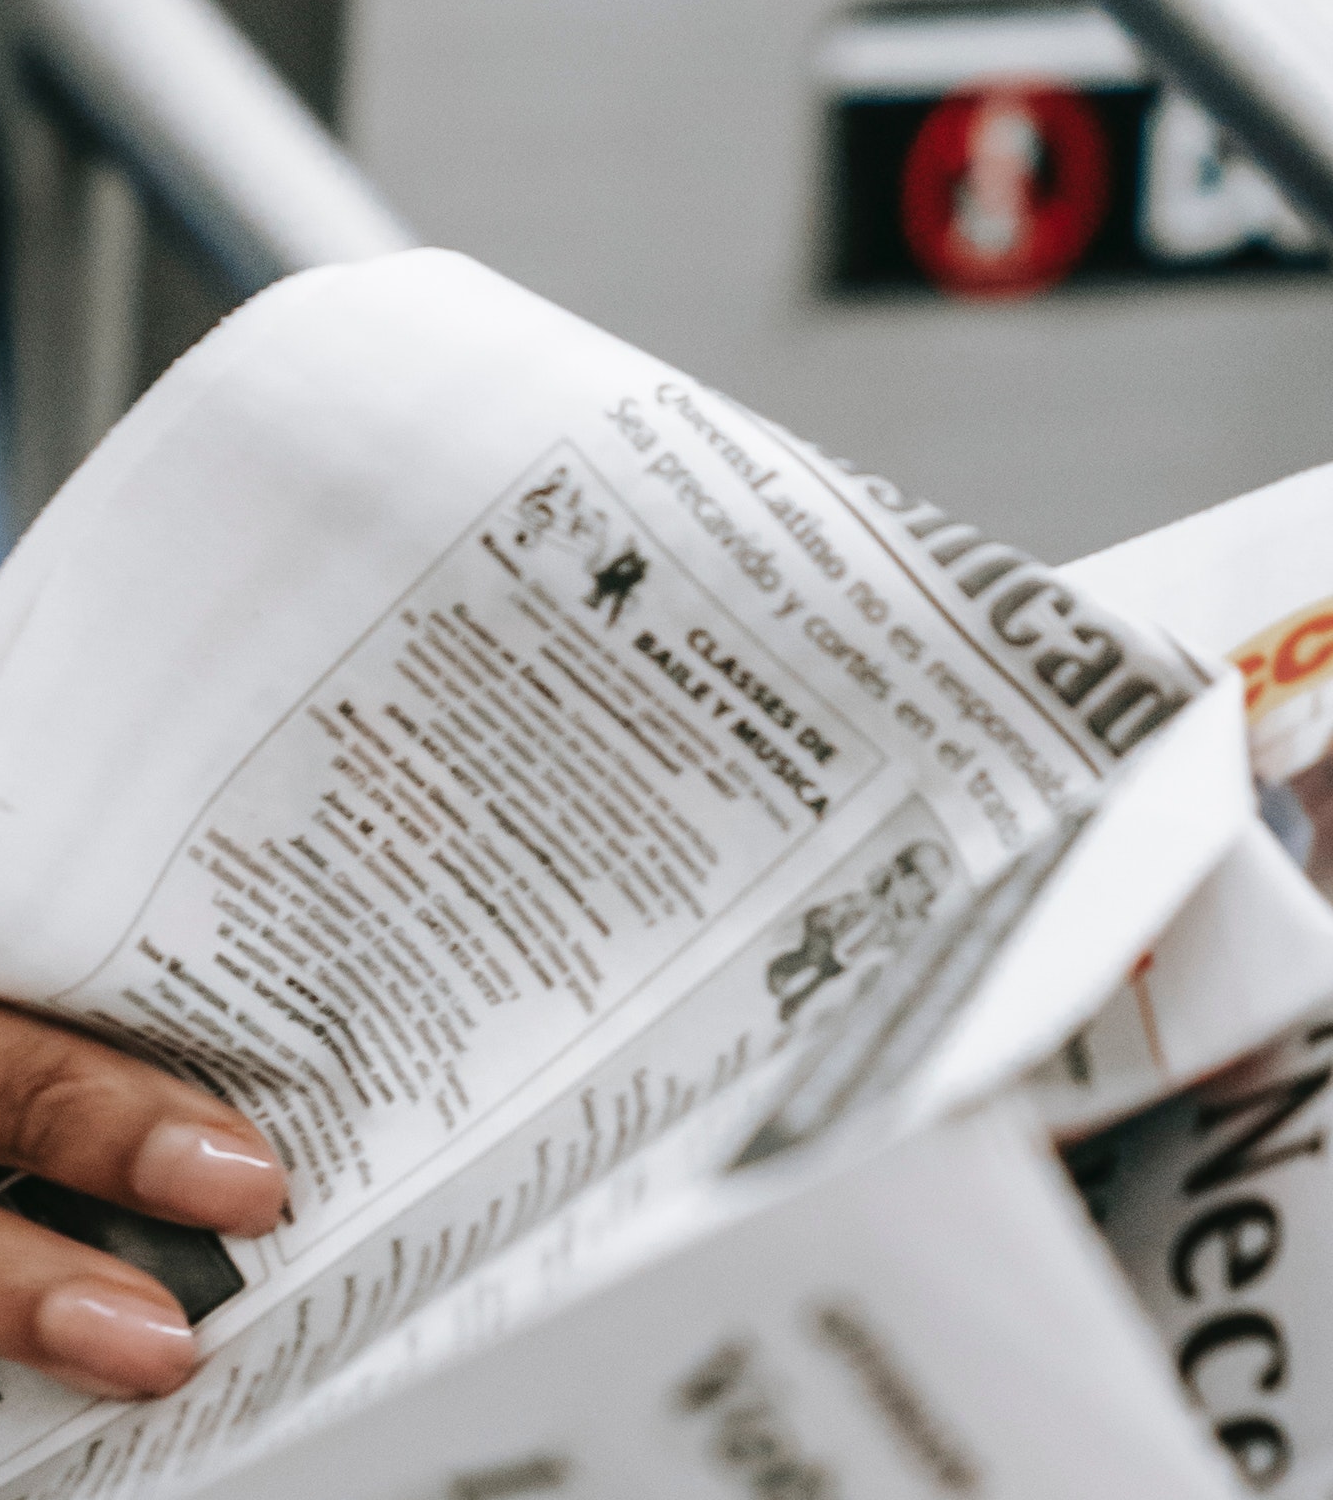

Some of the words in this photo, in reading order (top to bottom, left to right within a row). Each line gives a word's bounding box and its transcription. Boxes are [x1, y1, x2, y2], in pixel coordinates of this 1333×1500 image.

[606, 399, 657, 454] Sea
[650, 456, 783, 599] precavido
[771, 592, 803, 620] y
[804, 618, 891, 701] cortés
[894, 700, 935, 738] en
[936, 740, 974, 769] el
[845, 580, 890, 628] no
[886, 625, 926, 664] es
[634, 632, 710, 701] BAILE
[712, 699, 732, 717] Y
[731, 719, 827, 817] MUSICA
[687, 629, 797, 729] CLASSES
[796, 726, 836, 764] DE
